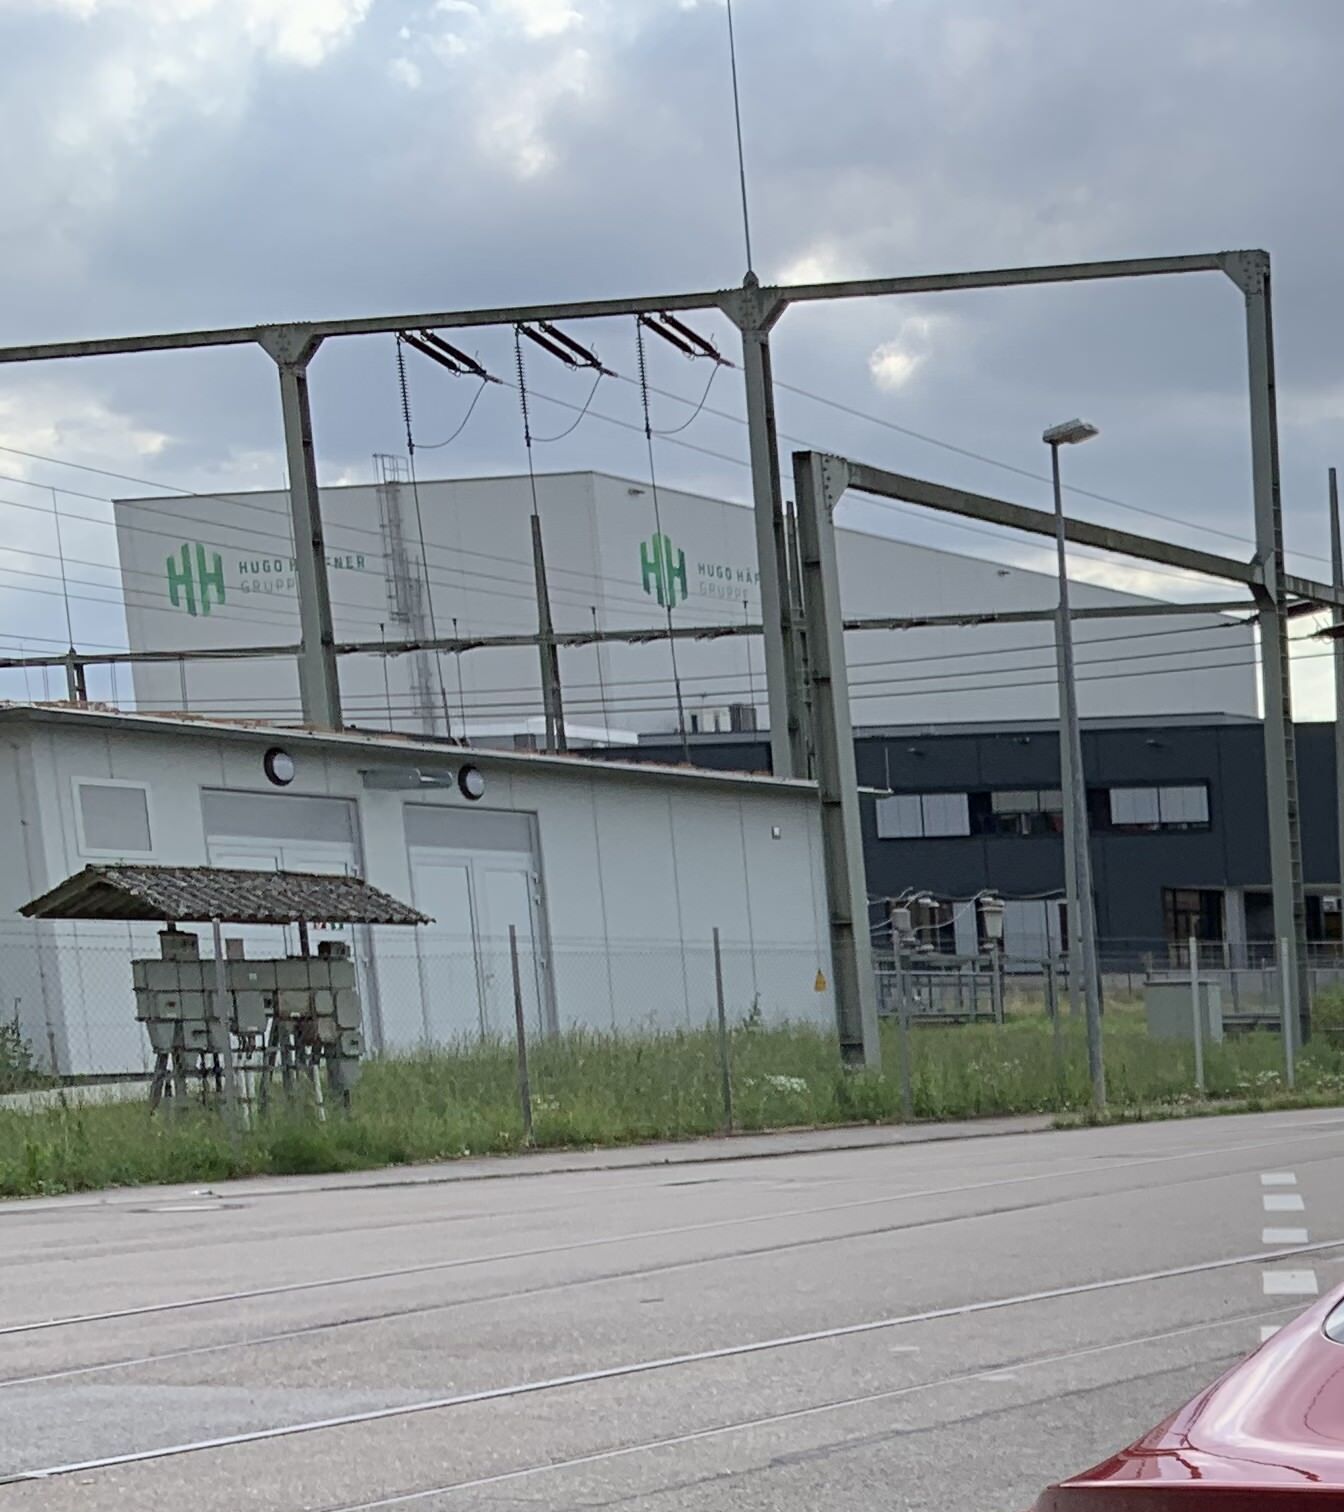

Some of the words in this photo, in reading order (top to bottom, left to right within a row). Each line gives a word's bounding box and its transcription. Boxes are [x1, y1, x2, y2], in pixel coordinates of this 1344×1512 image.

[238, 559, 283, 574] HUGO
[698, 563, 733, 581] HUGO
[240, 578, 296, 594] GRUPP
